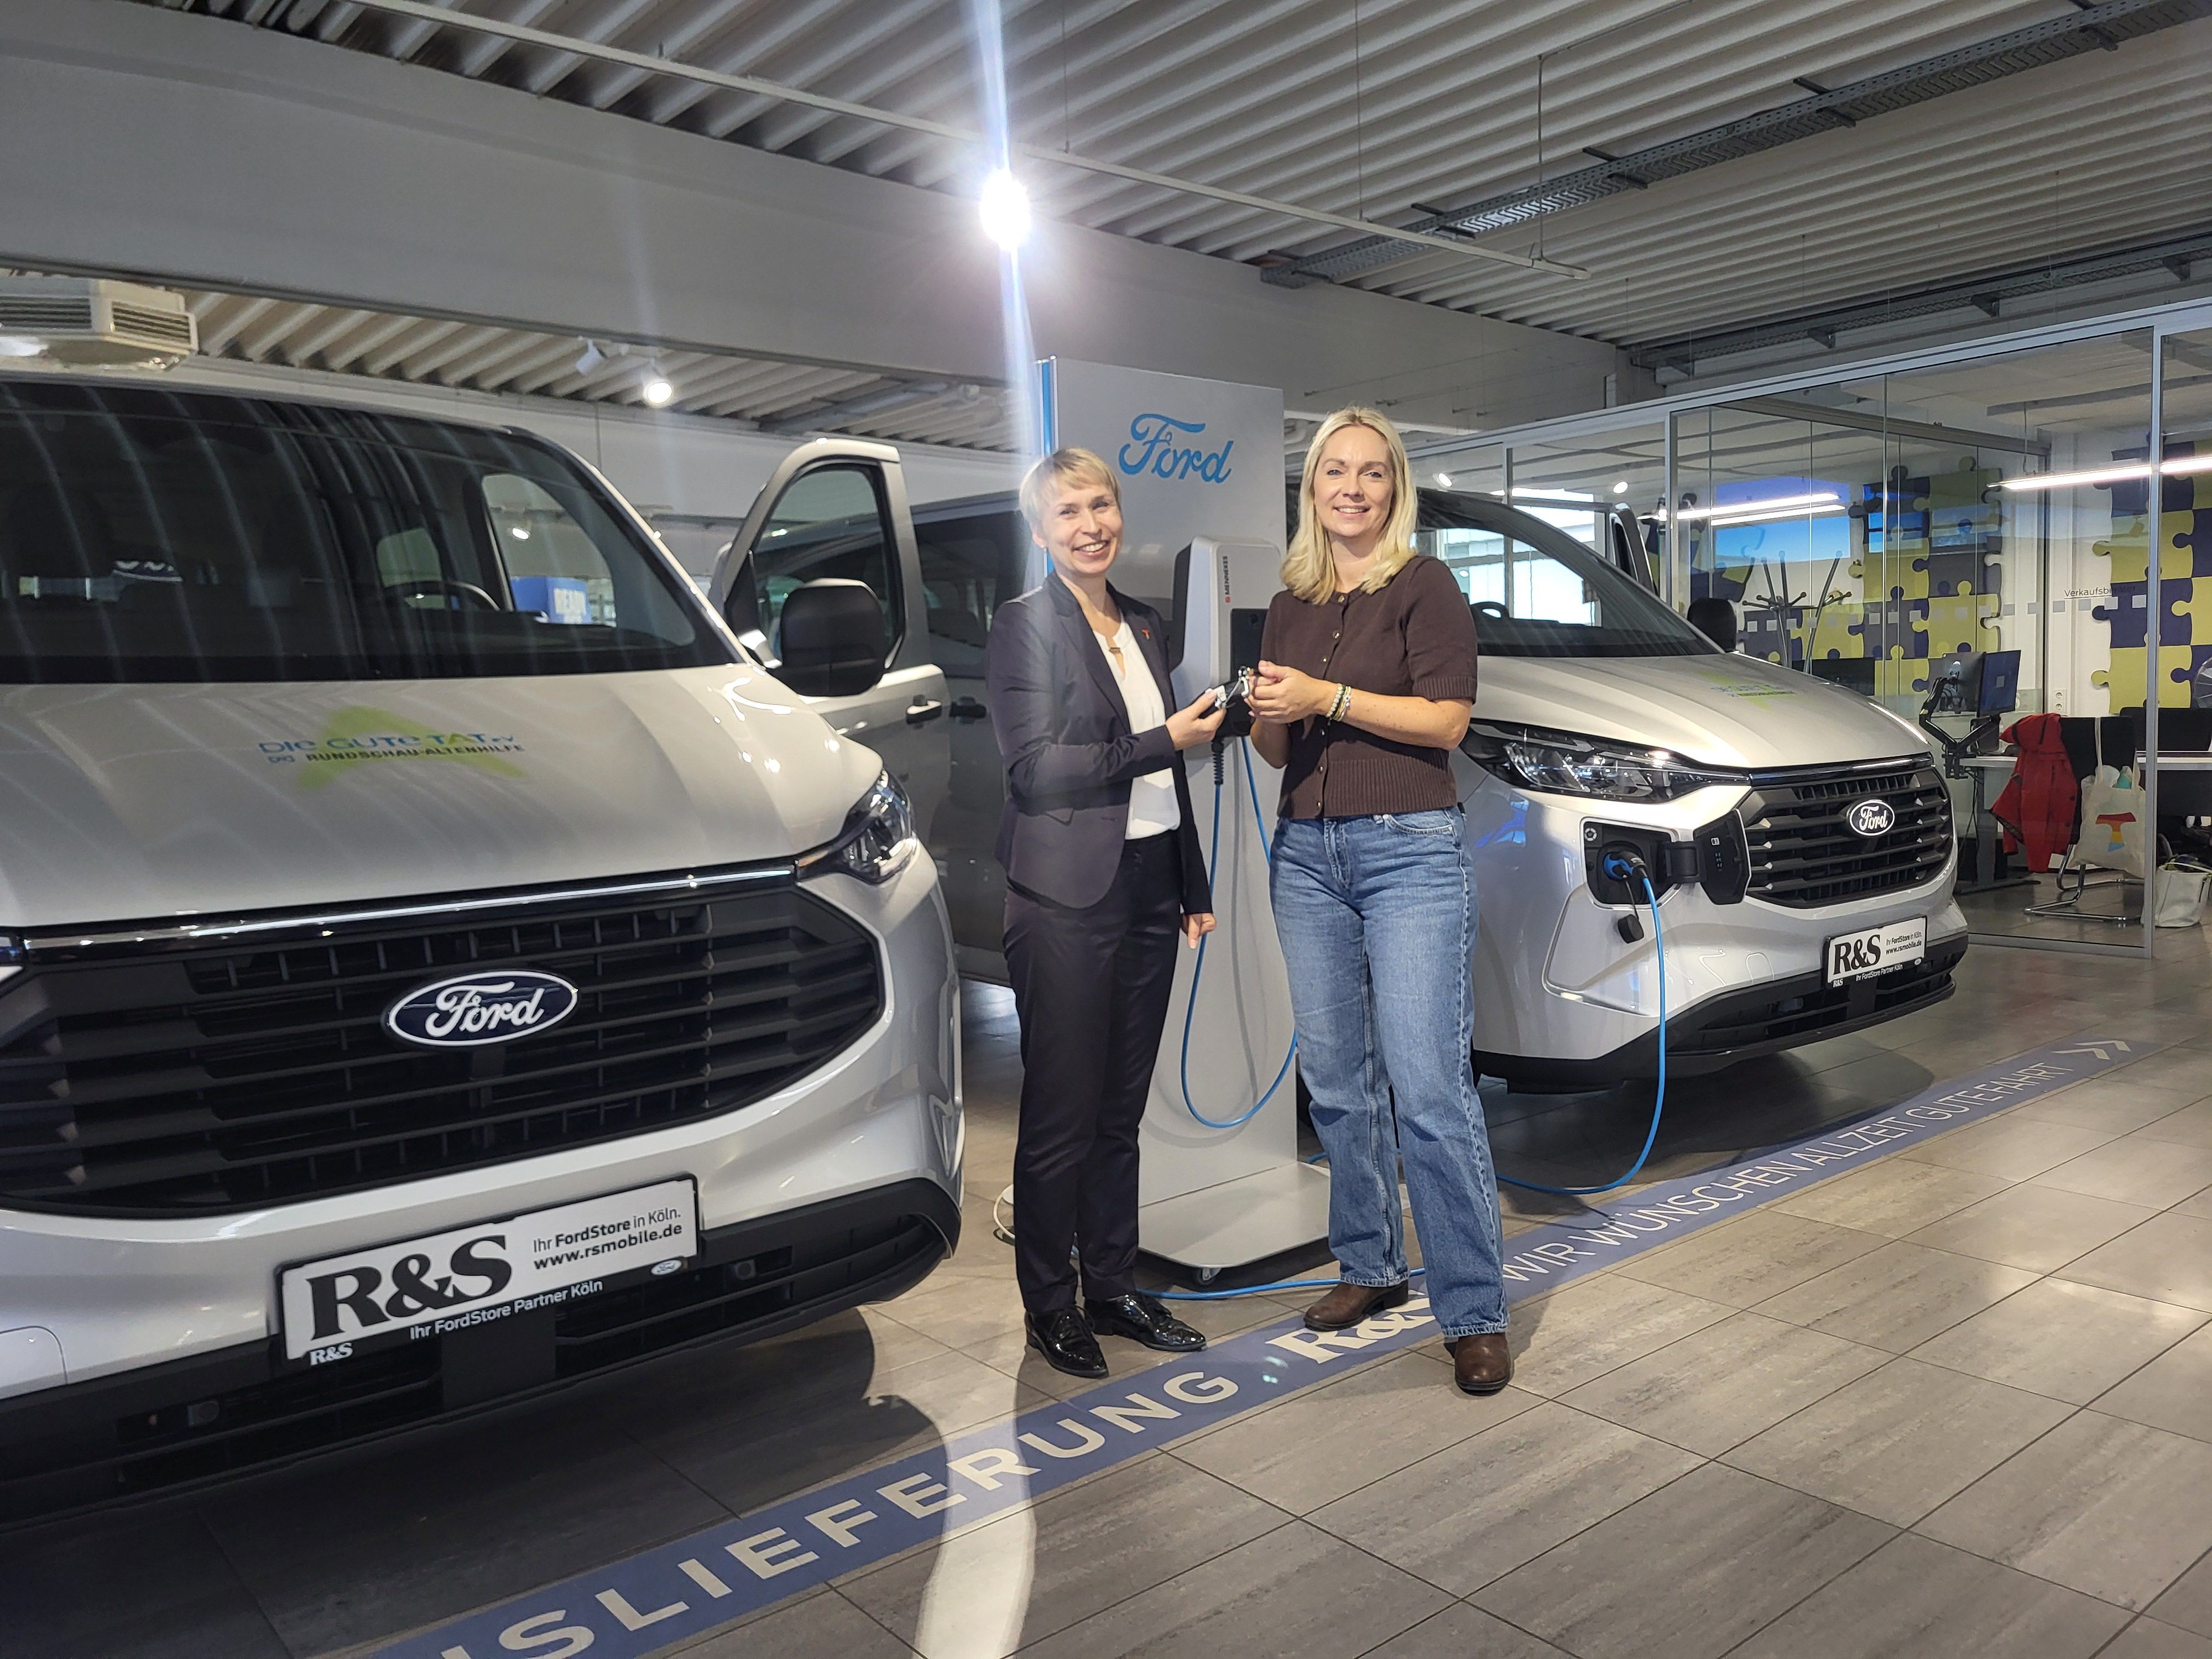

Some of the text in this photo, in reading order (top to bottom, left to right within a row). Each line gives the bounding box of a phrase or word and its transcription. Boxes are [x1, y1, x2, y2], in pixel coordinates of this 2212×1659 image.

[1118, 413, 1234, 483] Ford
[426, 733, 486, 745] TAT
[1859, 805, 1888, 831] Ford
[1833, 934, 1881, 975] R&S
[1886, 940, 1922, 955] www.rsmobile.de
[1892, 934, 1910, 945] FordStore
[1833, 978, 1843, 988] R&S
[1861, 970, 1880, 980] FordStore
[1881, 967, 1894, 975] Partner
[425, 980, 546, 1038] Ford
[1503, 1242, 1597, 1281] WIR
[1567, 1160, 1813, 1245] WÜNSCHEN
[1791, 1116, 1926, 1166] ALLZEIT
[1905, 1083, 2004, 1120] GUTE
[1990, 1062, 2074, 1094] FAHRT
[533, 1207, 681, 1253] Ihr FordStore in Köln.
[534, 1224, 682, 1270] www.rsmobile.de
[305, 1235, 512, 1341] R&S
[409, 1280, 603, 1340] Ihr FordStore Partner Köln
[309, 1342, 353, 1366] R&S
